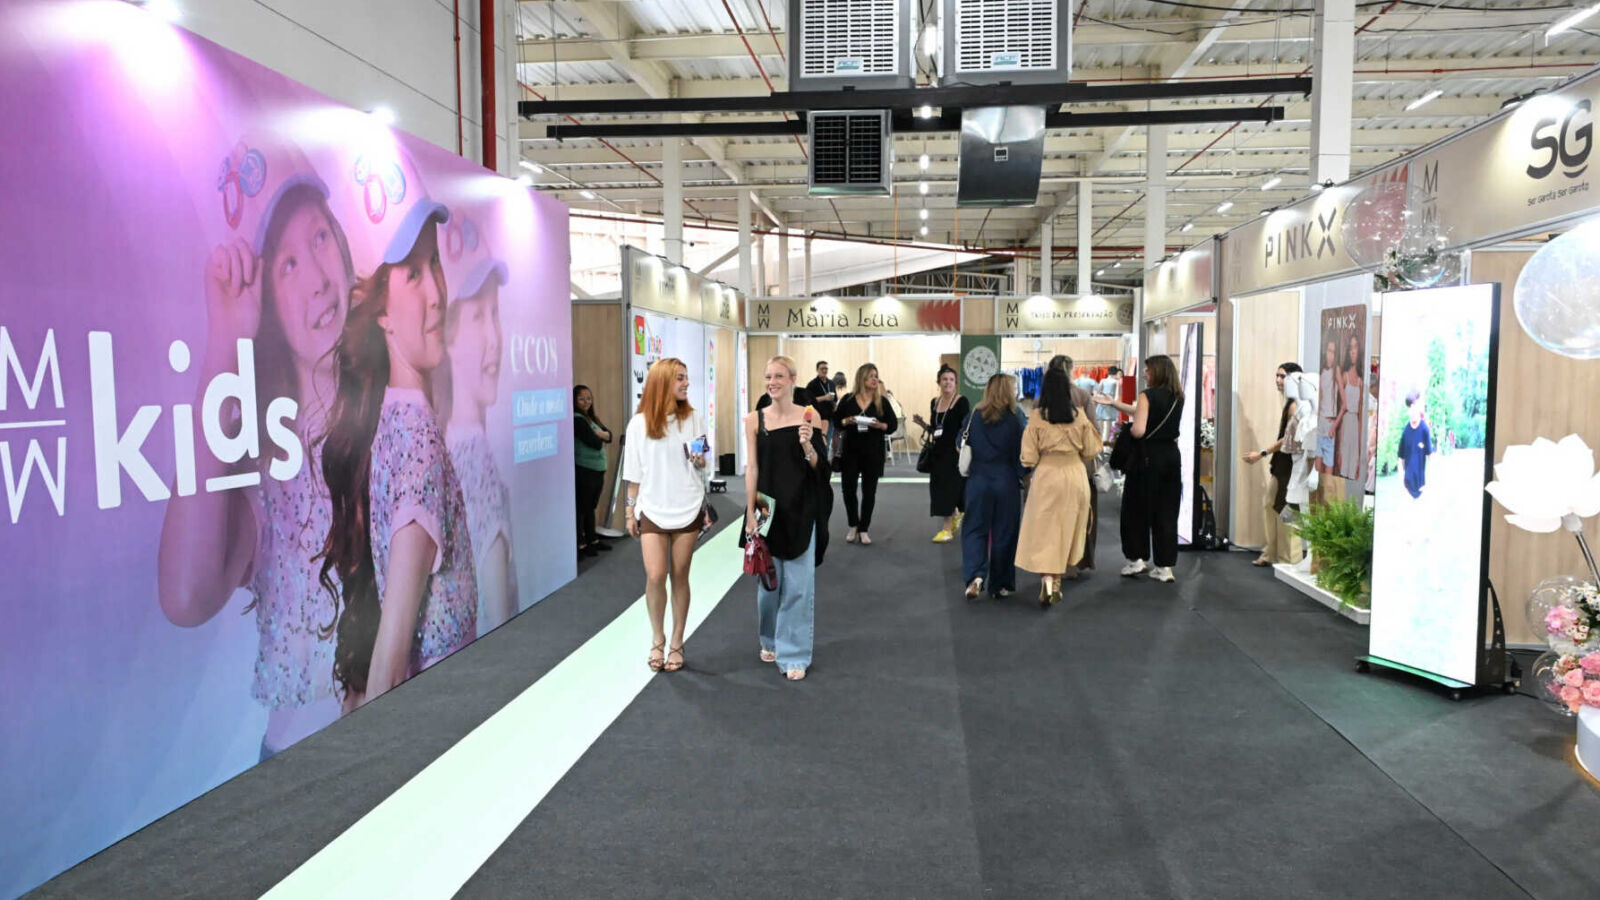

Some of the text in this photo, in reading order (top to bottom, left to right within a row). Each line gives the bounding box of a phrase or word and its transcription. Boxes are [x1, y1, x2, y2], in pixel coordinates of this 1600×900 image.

[1526, 98, 1593, 179] SG
[1423, 160, 1439, 194] M
[758, 304, 770, 314] M
[758, 318, 770, 328] W
[787, 307, 899, 327] Maria Lua
[1006, 303, 1019, 313] M
[1006, 317, 1019, 329] W
[0, 326, 65, 411] M
[510, 334, 558, 375] ecos
[88, 331, 303, 509] kids
[0, 437, 67, 524] W
